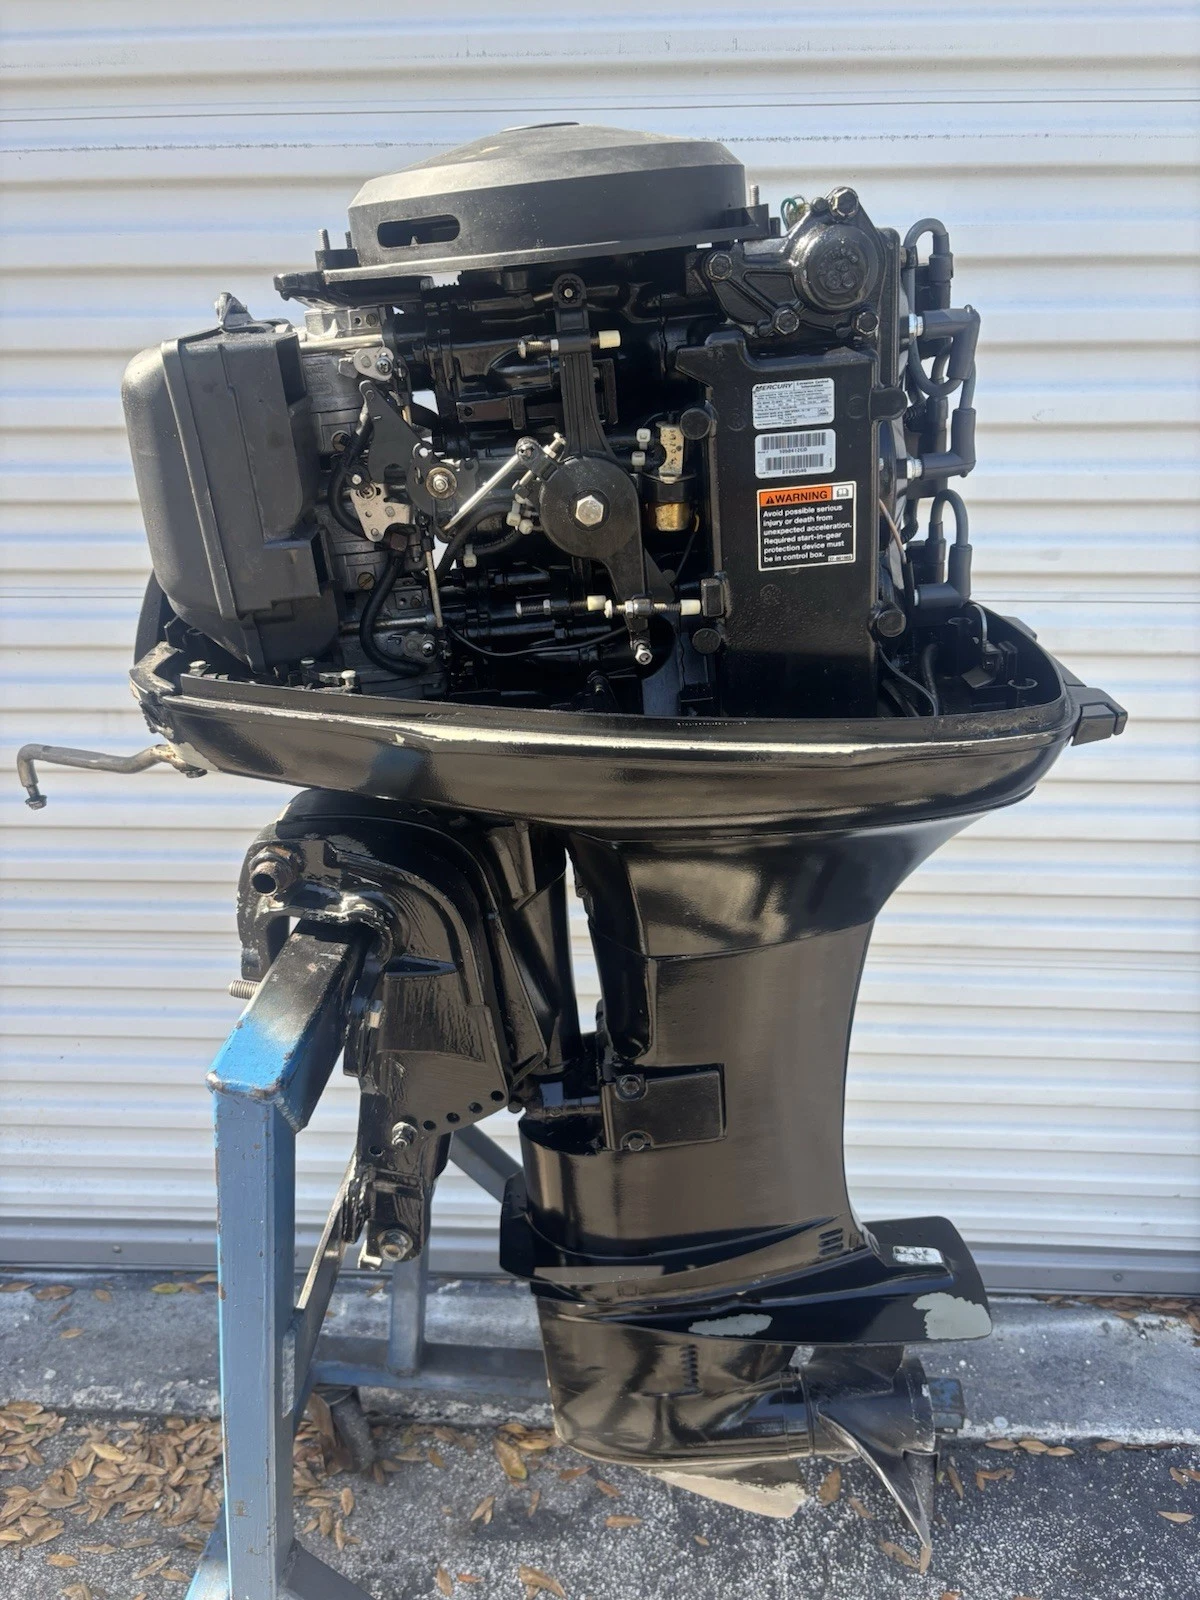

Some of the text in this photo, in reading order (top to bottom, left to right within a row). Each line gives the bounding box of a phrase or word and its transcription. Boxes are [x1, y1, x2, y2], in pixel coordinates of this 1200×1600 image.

[755, 383, 792, 391] MERCURY
[775, 491, 827, 503] WARNING
[785, 507, 815, 516] possible
[794, 516, 815, 524] death
[764, 522, 852, 536] unexpected acceleration.
[764, 532, 842, 545] Required start-in-gear
[764, 544, 800, 554] protection
[802, 542, 824, 550] device
[783, 552, 808, 560] control
